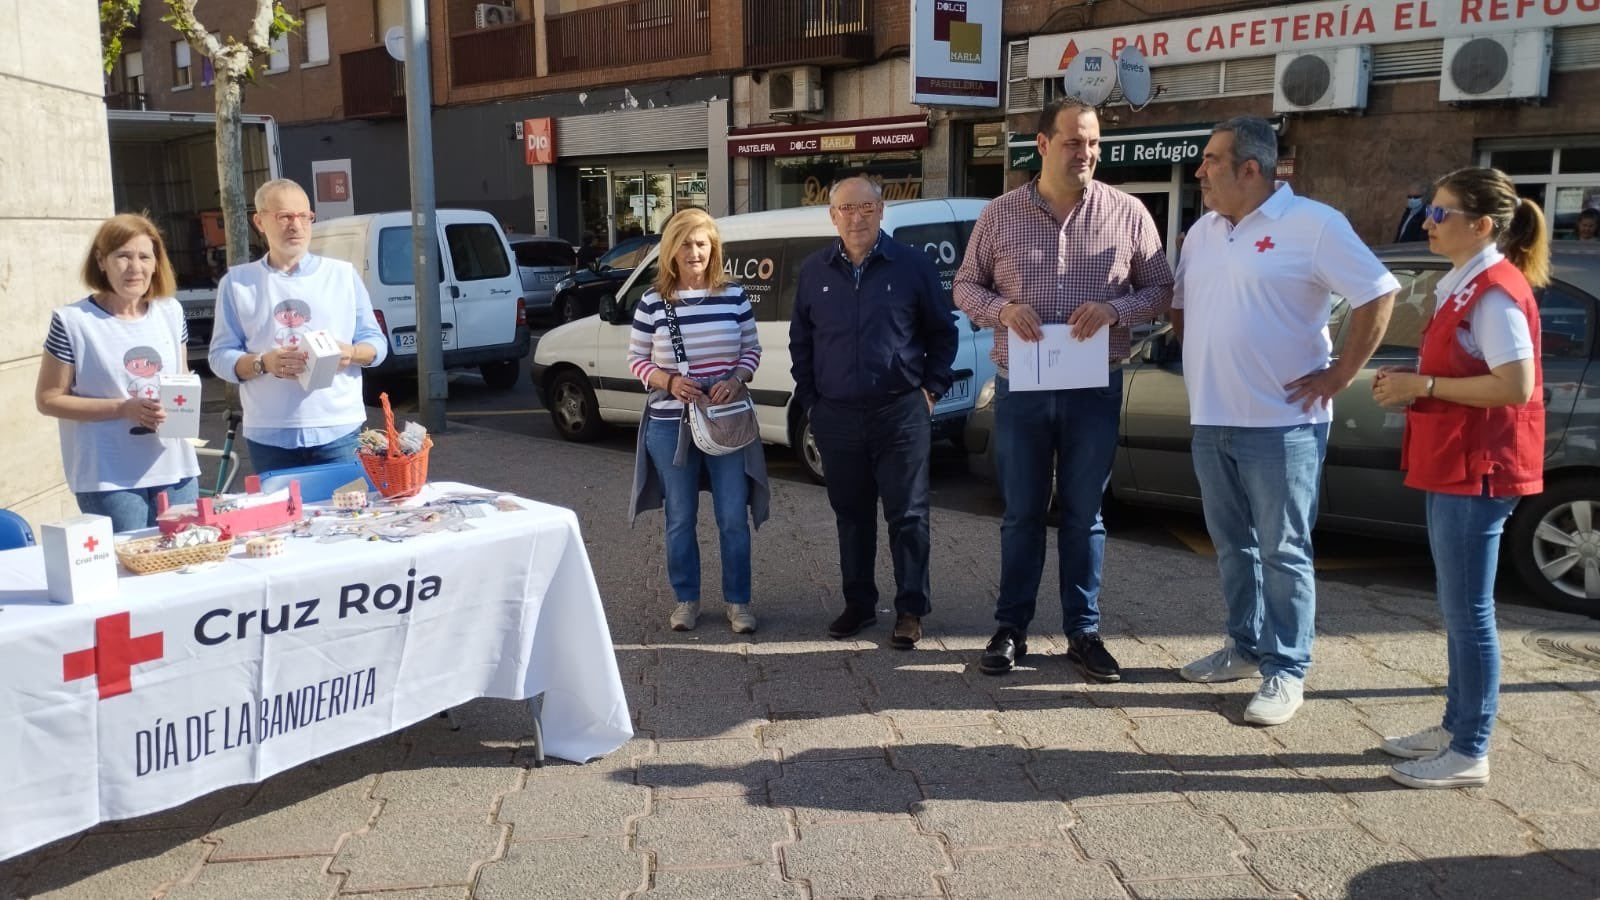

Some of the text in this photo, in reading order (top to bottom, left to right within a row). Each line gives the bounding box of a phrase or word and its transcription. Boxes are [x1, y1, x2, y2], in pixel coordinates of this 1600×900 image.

[936, 2, 966, 13] DOLCE
[1186, 4, 1376, 53] CAFETERÍA
[1394, 1, 1437, 32] EL
[950, 52, 981, 62] MARLA
[738, 143, 776, 153] PASTELERIA
[790, 140, 817, 151] DOLCE
[872, 134, 915, 145] PANADERIA
[1111, 144, 1125, 162] El
[1134, 140, 1199, 163] Refugio
[193, 568, 443, 646] Cruz Roja
[135, 667, 377, 777] DÍA DE LA BANDERITA
